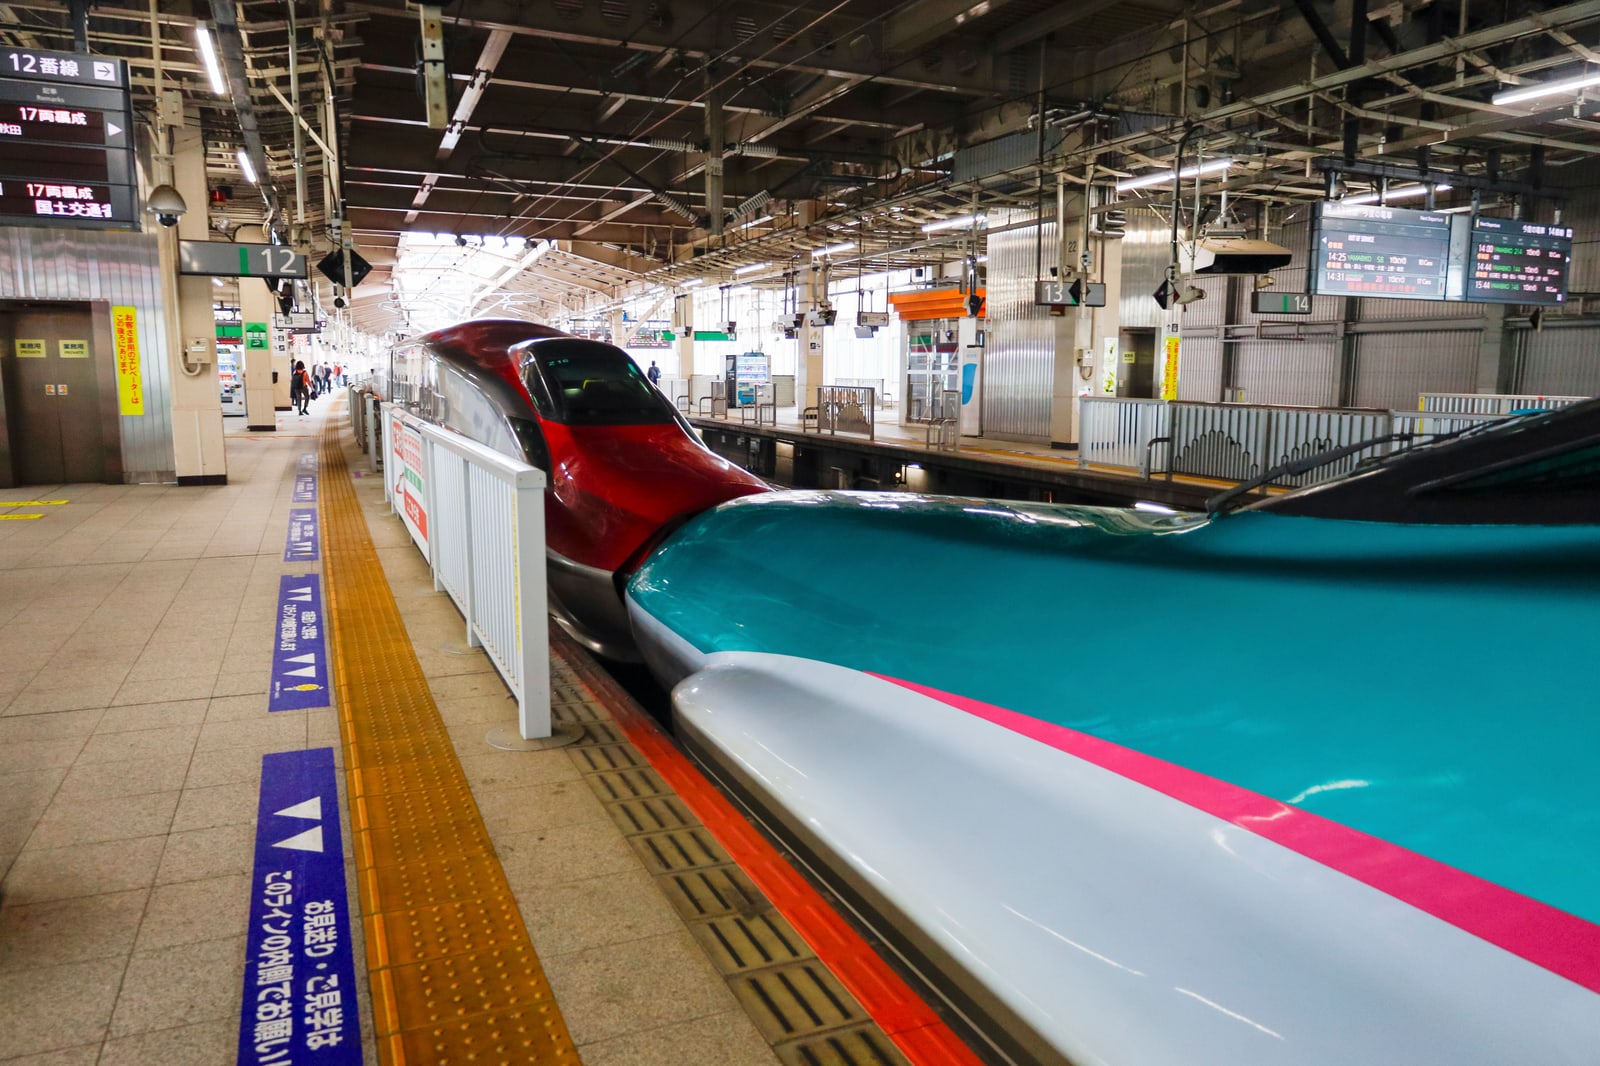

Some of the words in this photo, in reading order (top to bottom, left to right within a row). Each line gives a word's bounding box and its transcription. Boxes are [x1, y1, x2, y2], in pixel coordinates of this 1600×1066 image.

[9, 53, 79, 76] 12番線
[36, 95, 65, 103] Remarks
[19, 107, 87, 125] 17両編成
[26, 183, 93, 200] 17両編成
[1068, 240, 1077, 253] 22
[1479, 244, 1494, 253] 14:00
[260, 248, 297, 274] 12
[1328, 252, 1347, 262] 14:25
[1477, 262, 1492, 271] 14:44
[1327, 272, 1345, 281] 14:31
[1045, 285, 1063, 302] 13
[1294, 296, 1309, 312] 14
[303, 900, 344, 1051] お見送り・ご見学は
